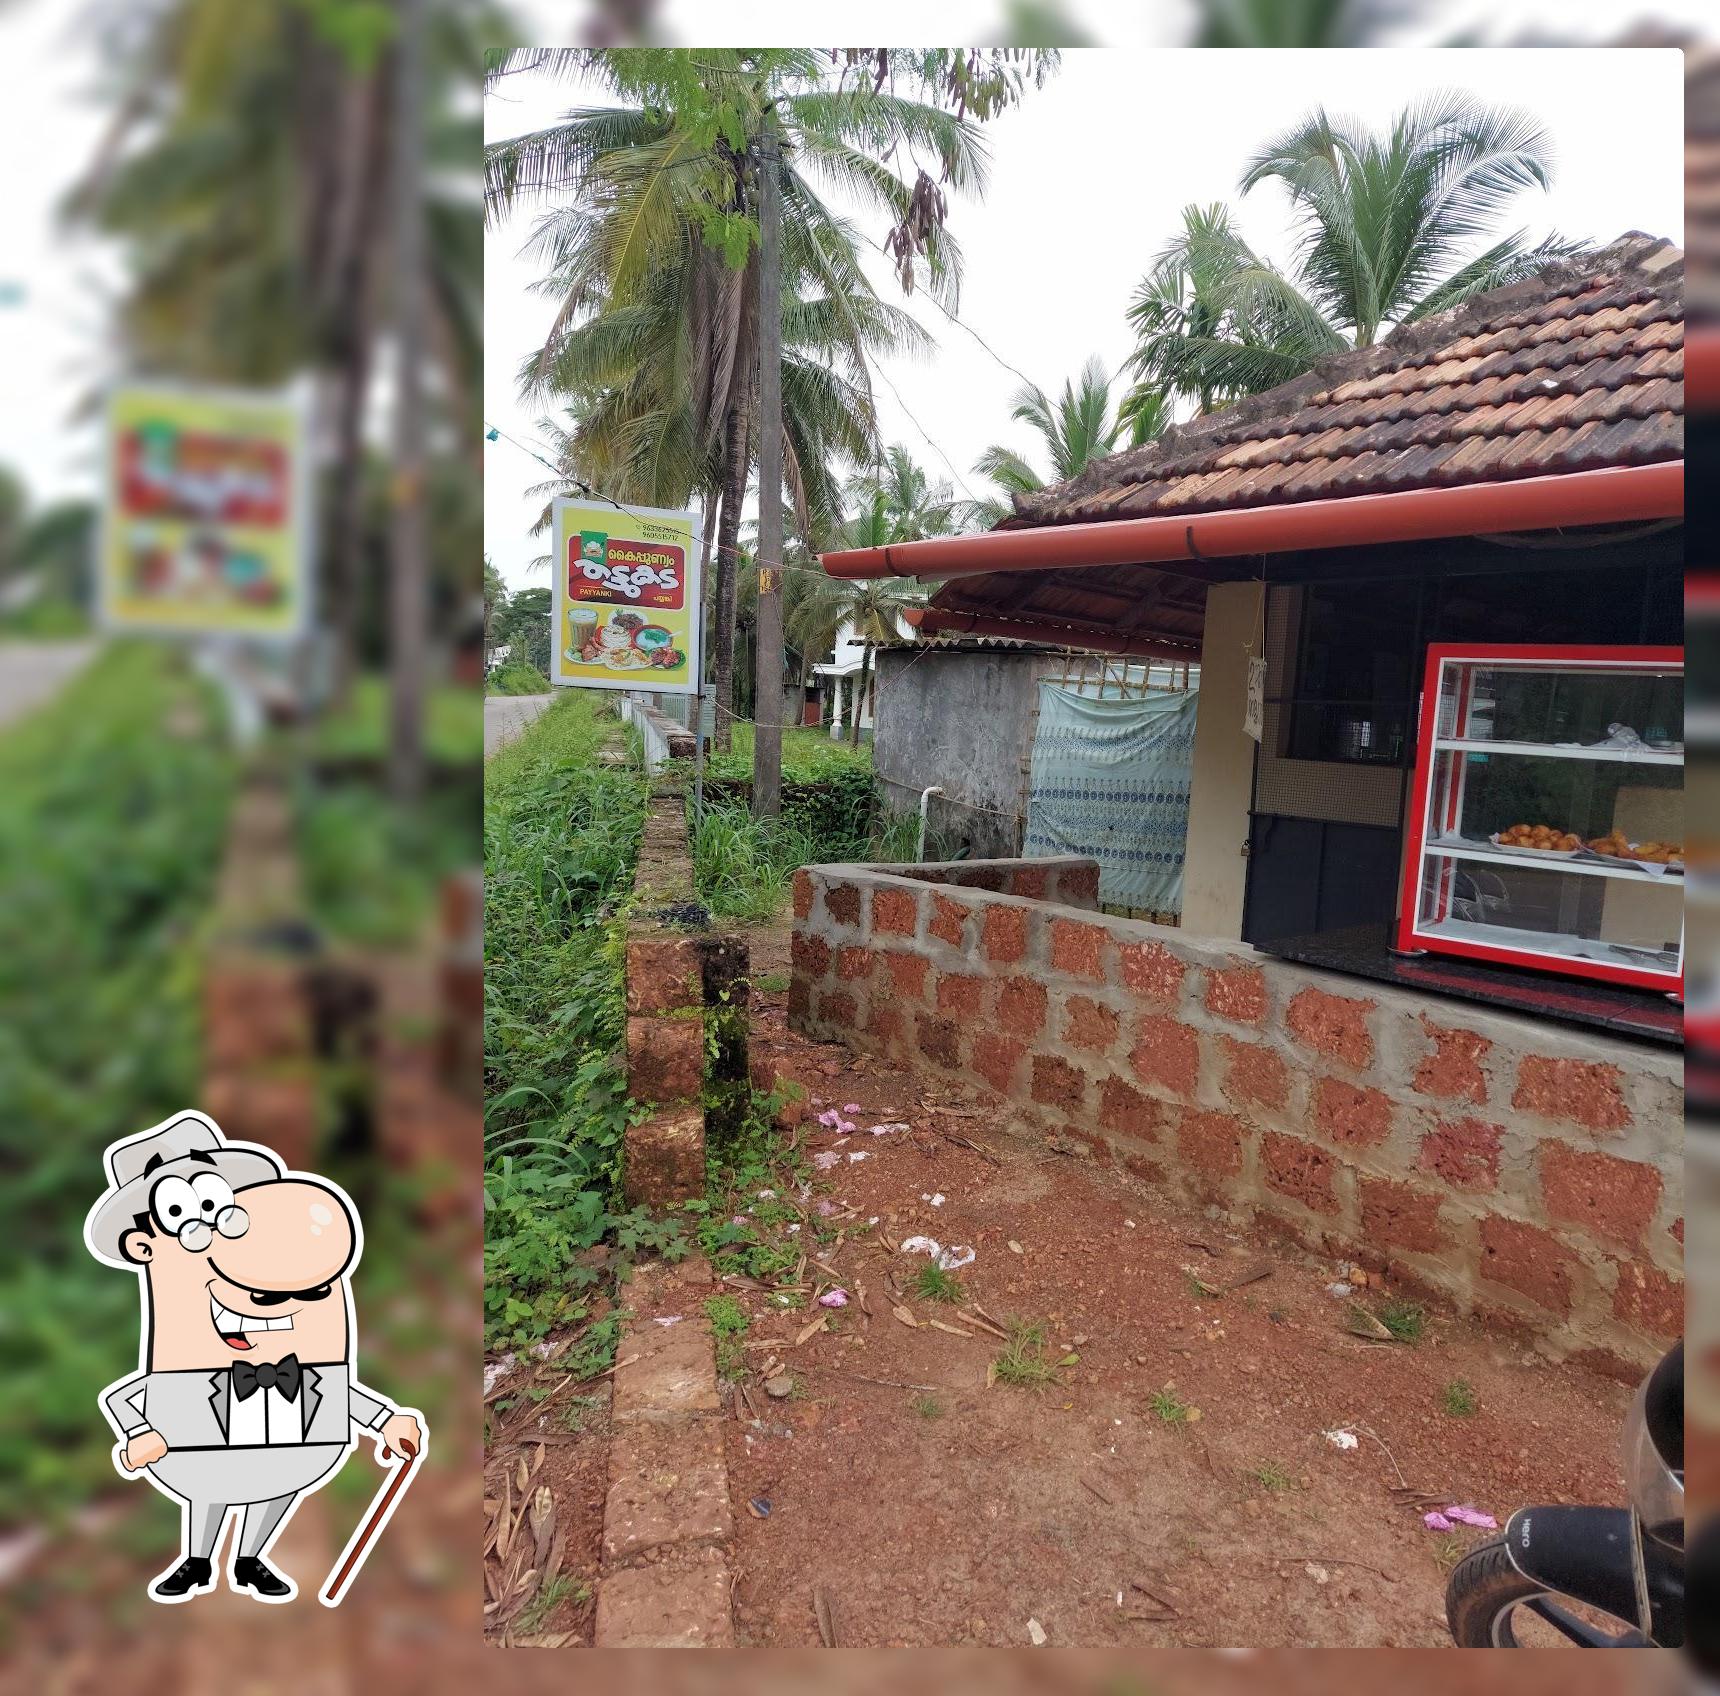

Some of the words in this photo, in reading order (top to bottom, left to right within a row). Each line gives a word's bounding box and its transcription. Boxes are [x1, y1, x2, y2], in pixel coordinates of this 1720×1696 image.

[573, 558, 680, 598] തട്ടുകട
[579, 589, 612, 597] PAYYANKI
[1522, 1518, 1532, 1548] Hero
